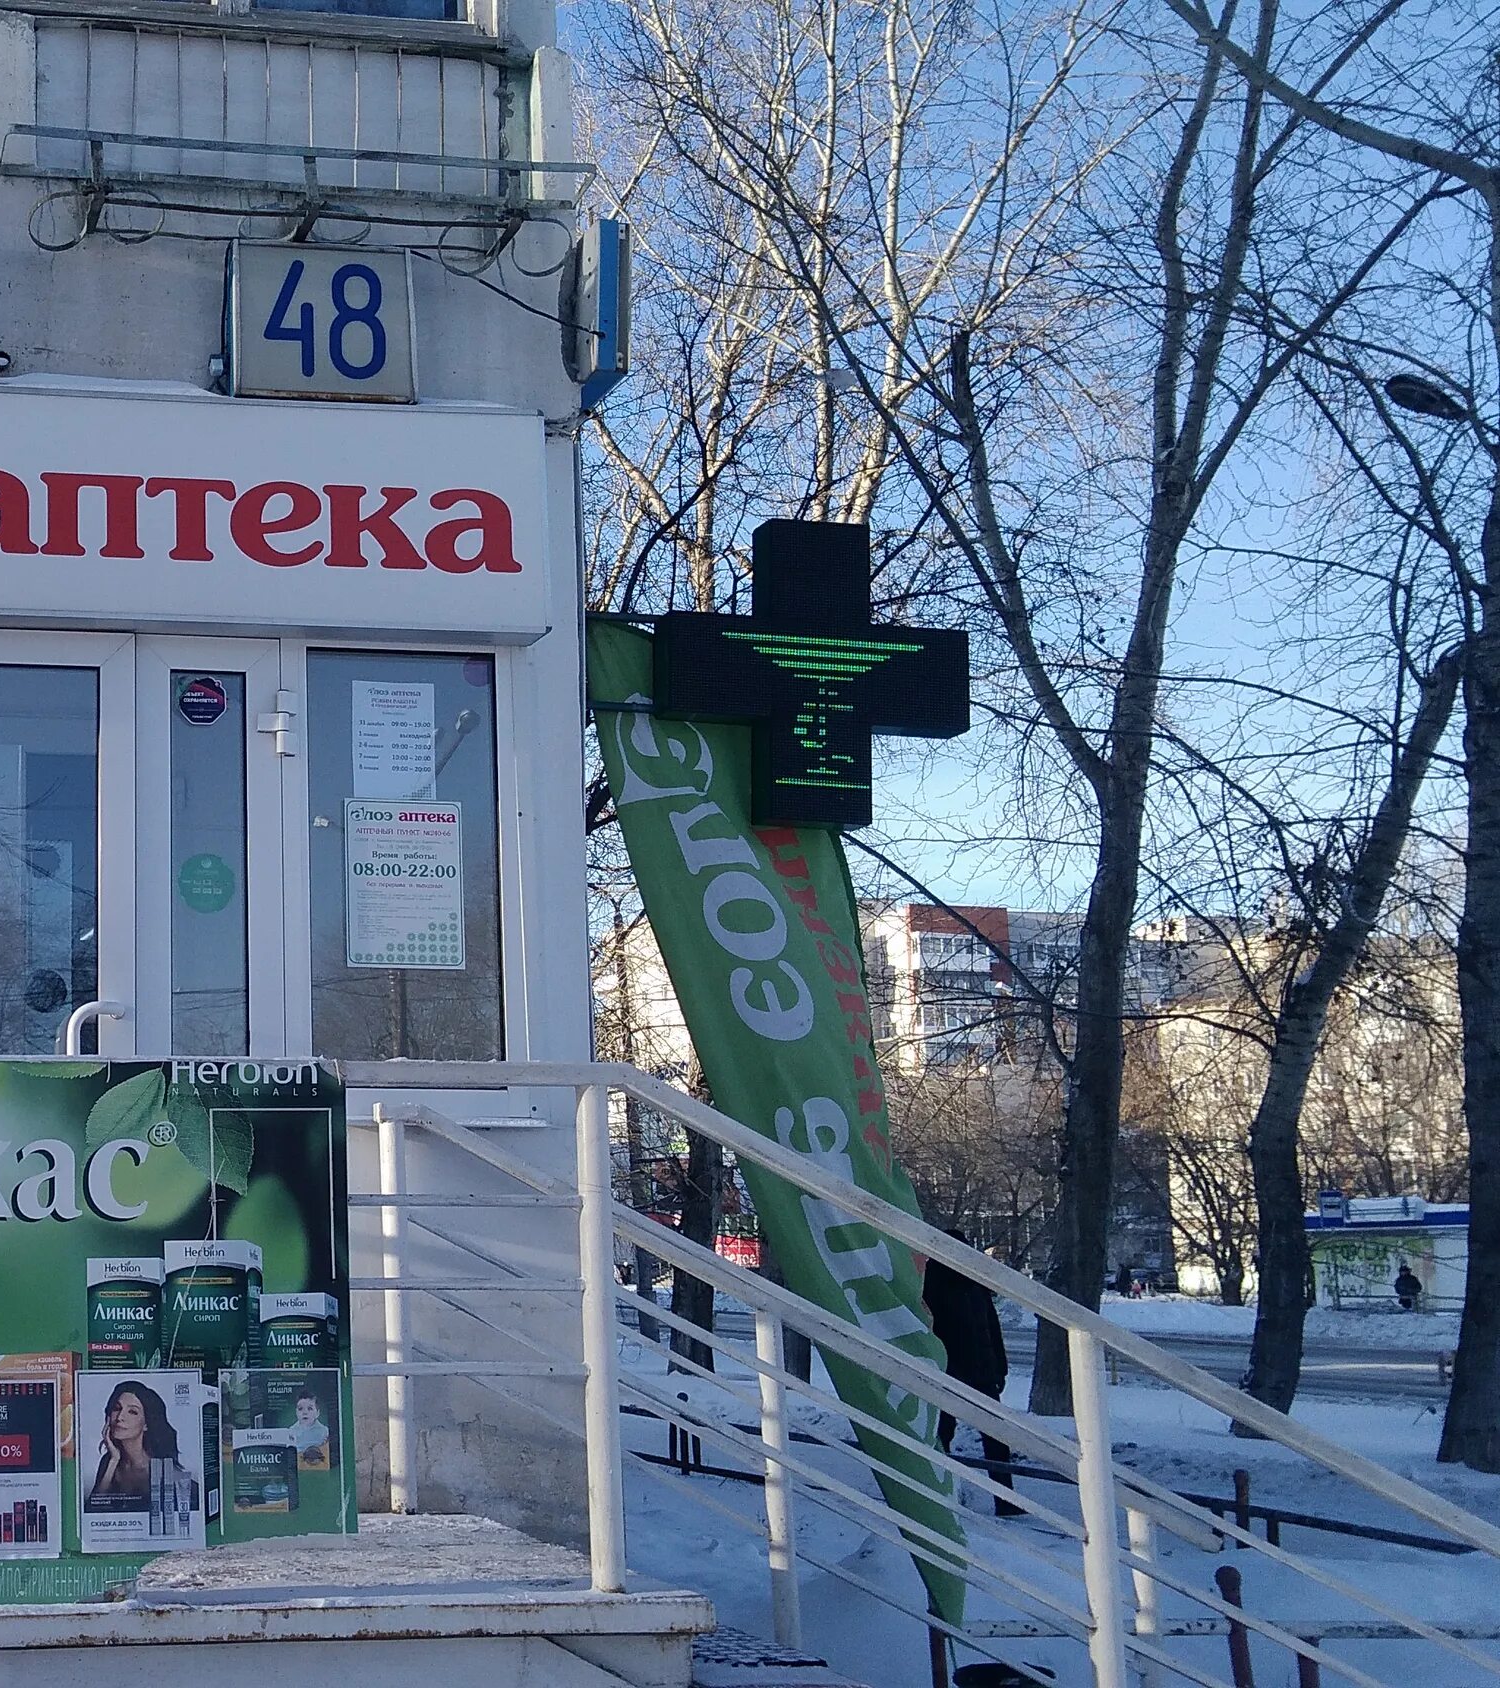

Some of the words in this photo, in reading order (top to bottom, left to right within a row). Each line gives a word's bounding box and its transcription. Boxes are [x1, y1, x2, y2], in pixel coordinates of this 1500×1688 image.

[263, 259, 387, 380] 48
[398, 811, 457, 823] аптека
[371, 850, 399, 859] Время
[353, 862, 457, 878] 08:00-22:00
[171, 1087, 318, 1097] NATURALS
[184, 1245, 225, 1258] Herbion
[104, 1262, 141, 1273] Herbion
[172, 1291, 240, 1311] Линкас
[276, 1297, 308, 1308] Herbion
[93, 1302, 154, 1320] Линкас
[113, 1322, 135, 1331] Сироп
[266, 1330, 319, 1346] Линкас
[237, 1450, 283, 1465] Линкас
